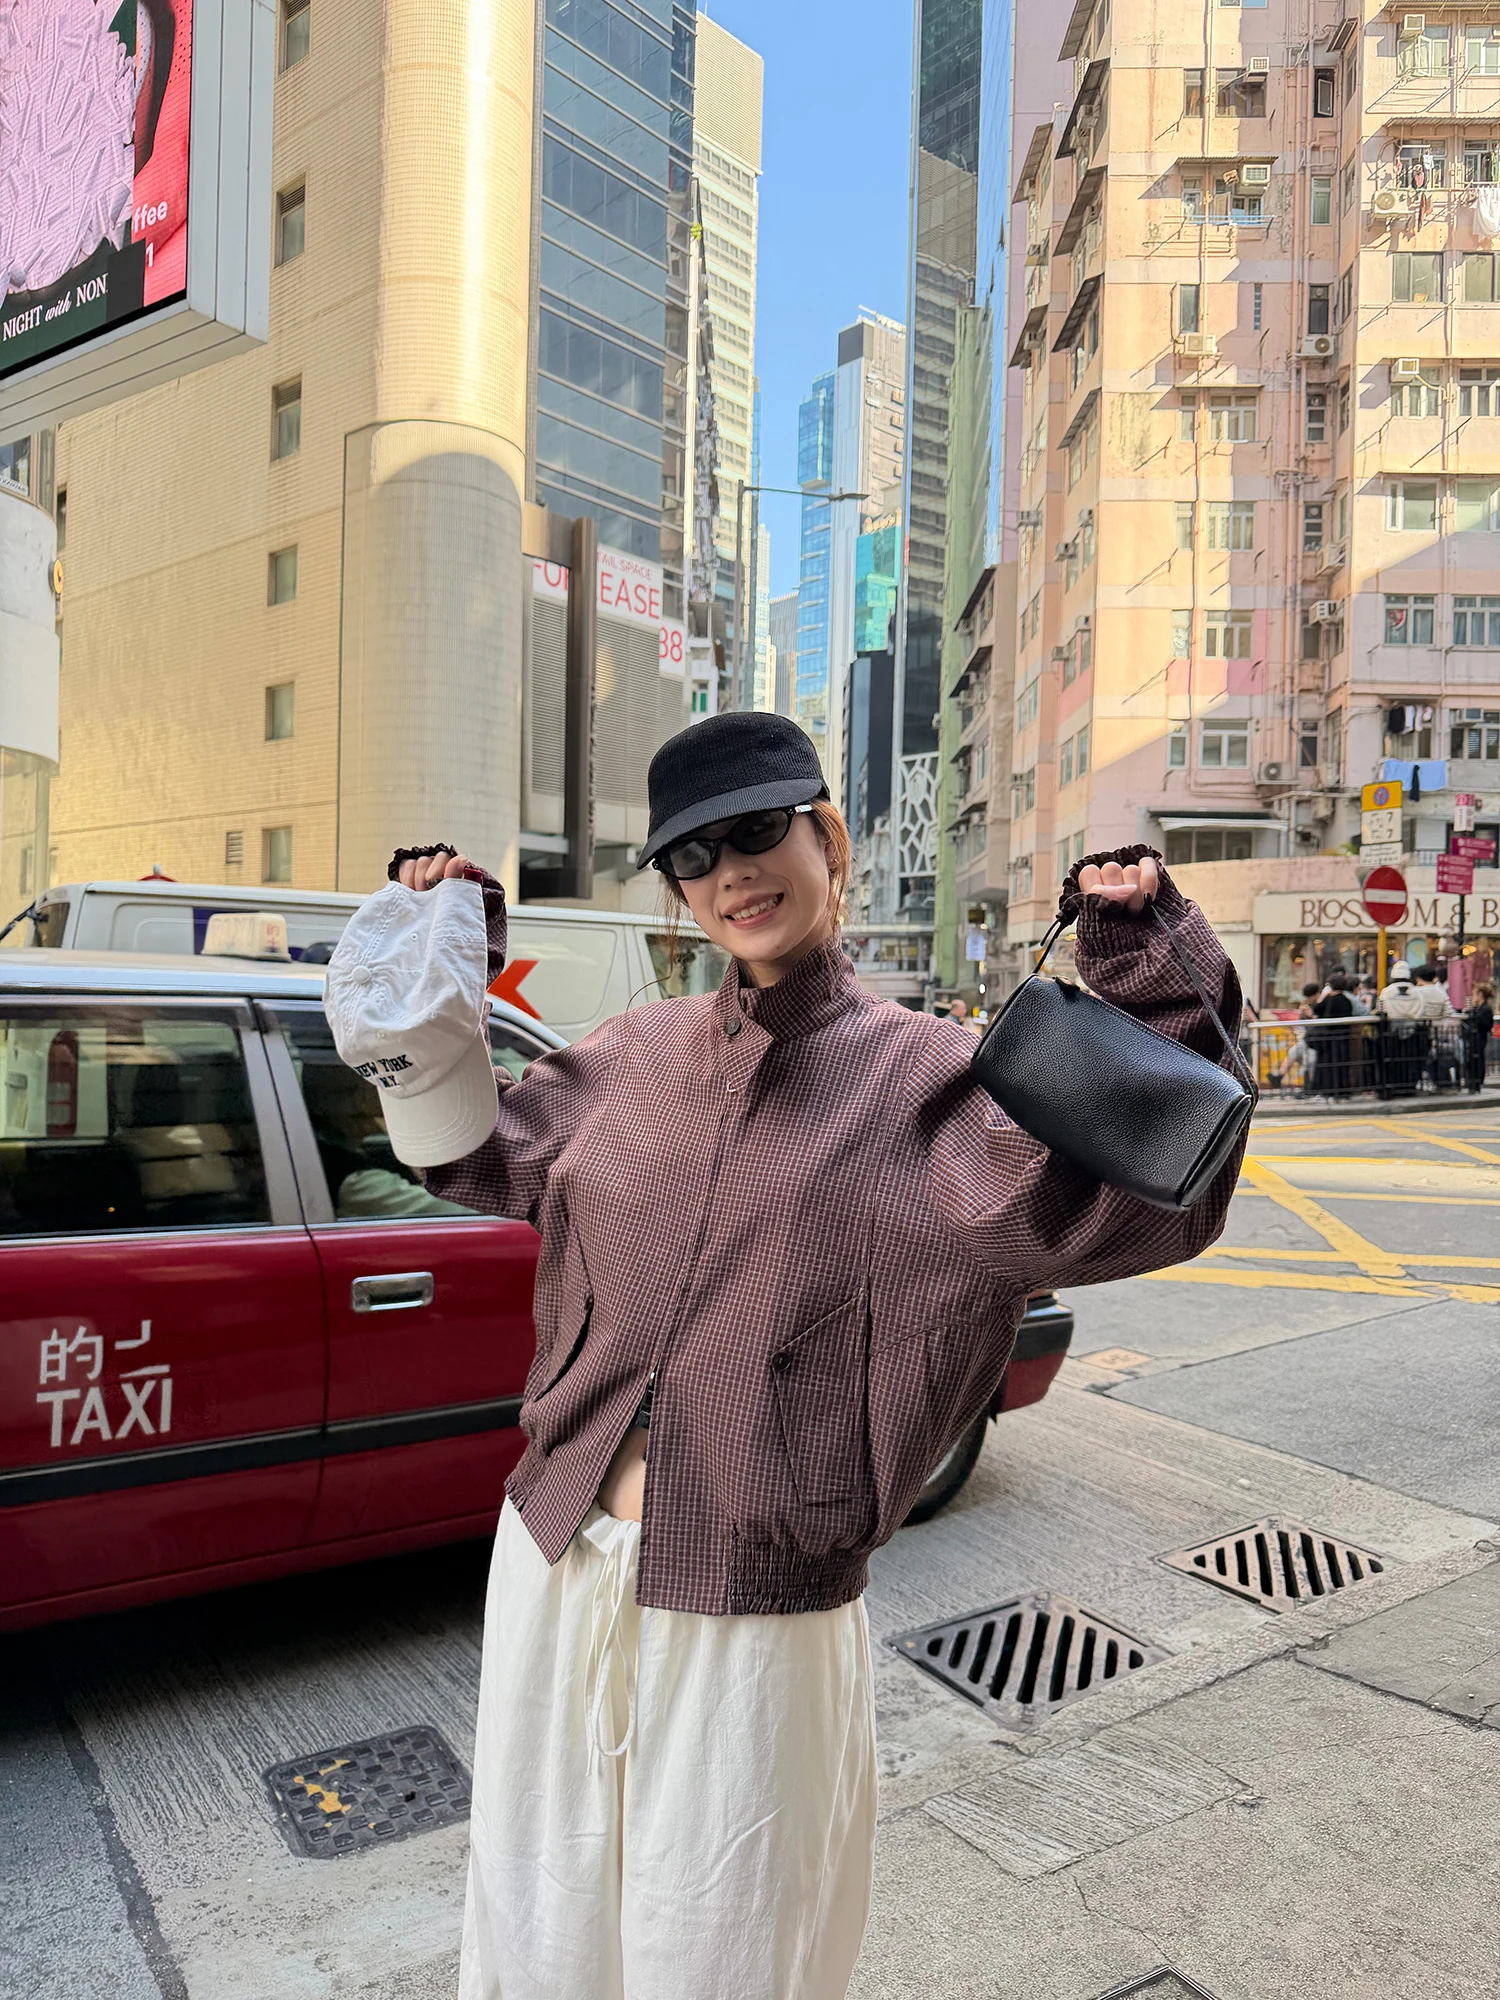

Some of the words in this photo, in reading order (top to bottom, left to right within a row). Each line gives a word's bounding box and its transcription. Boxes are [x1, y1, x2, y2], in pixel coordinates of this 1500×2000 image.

[2, 305, 43, 341] NIGHT
[45, 291, 72, 322] with
[619, 559, 652, 580] SPACE
[1300, 898, 1440, 929] BLOSM
[377, 1054, 414, 1072] YORK
[36, 1378, 173, 1447] TAXI
